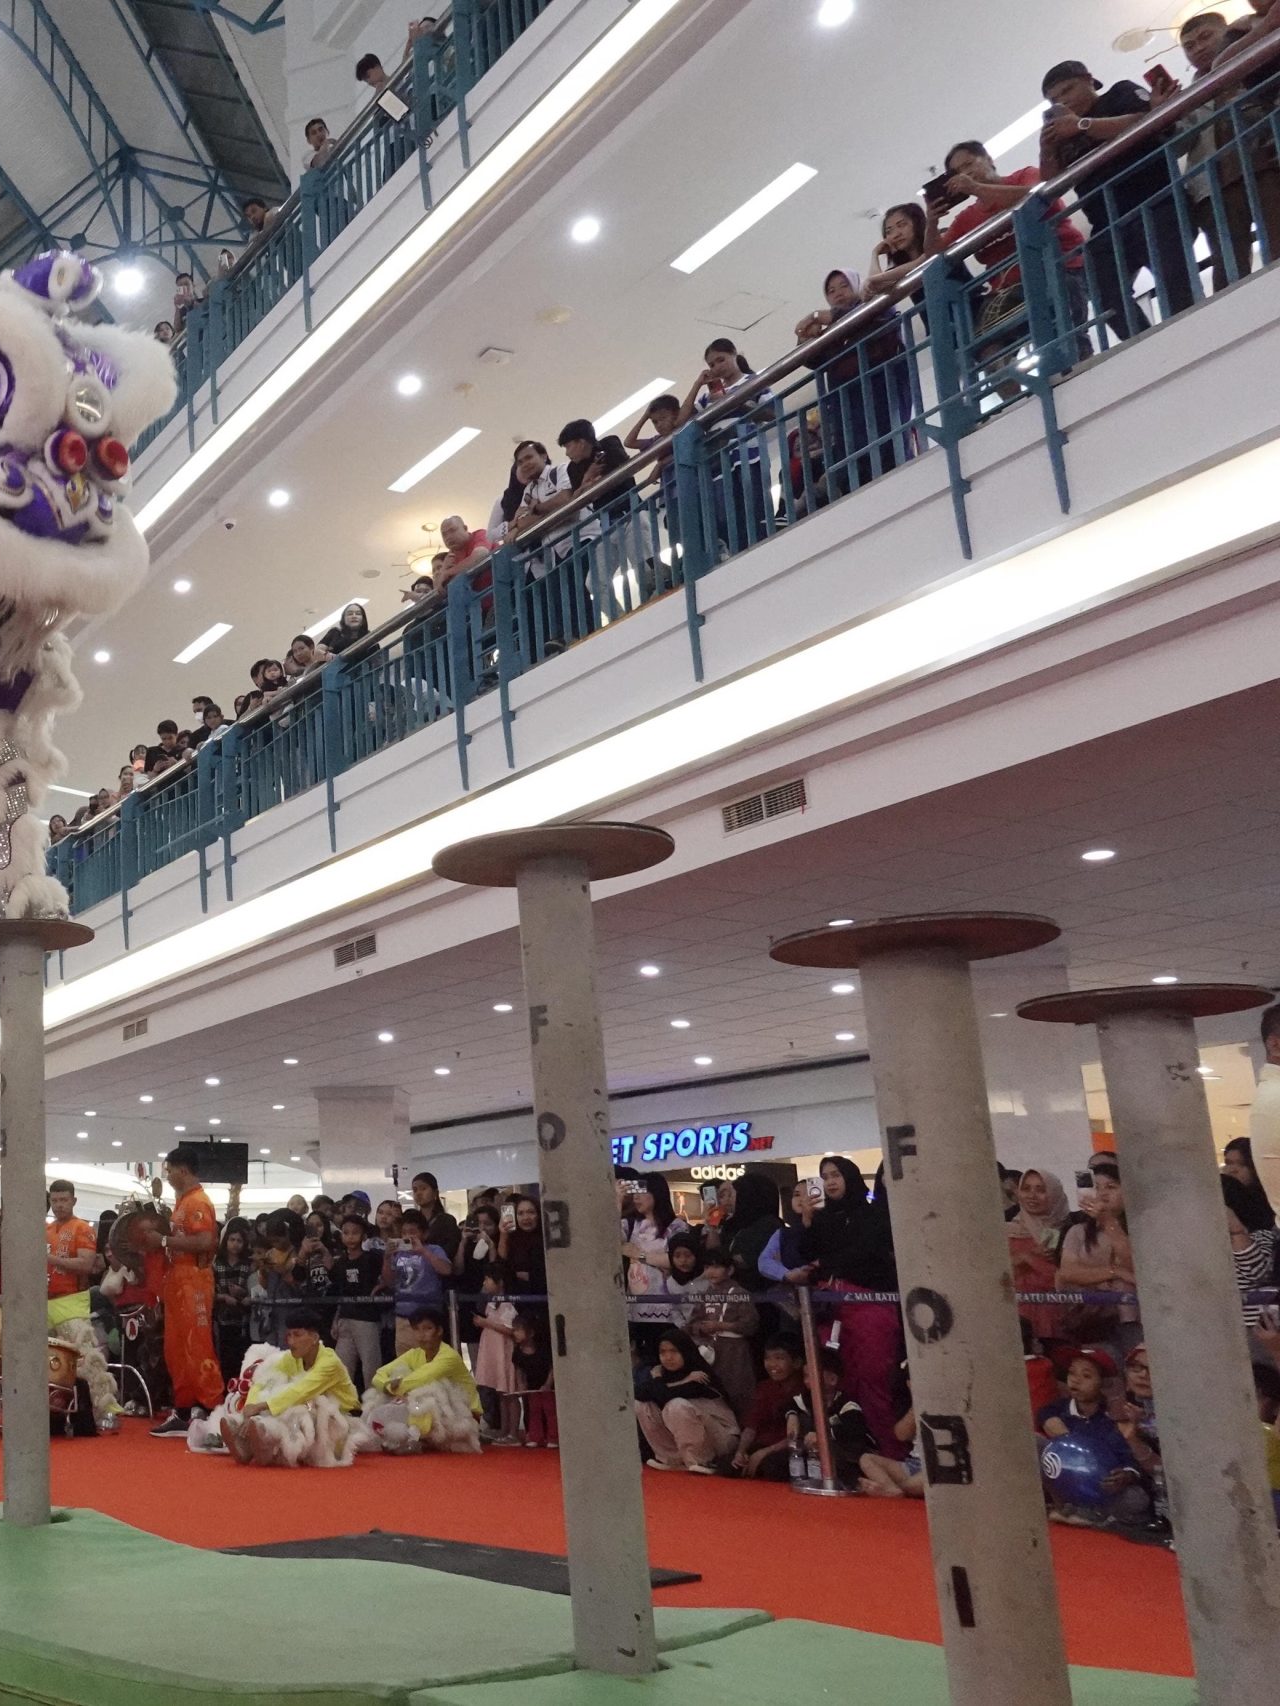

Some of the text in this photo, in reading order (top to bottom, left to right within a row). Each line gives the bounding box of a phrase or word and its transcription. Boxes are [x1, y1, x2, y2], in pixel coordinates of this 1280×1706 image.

[642, 1121, 752, 1162] SPORTS
[690, 1164, 745, 1181] adidas
[705, 1293, 724, 1303] RATU
[726, 1294, 750, 1303] INDAH
[854, 1292, 874, 1302] MAL
[1046, 1293, 1085, 1304] INDAH
